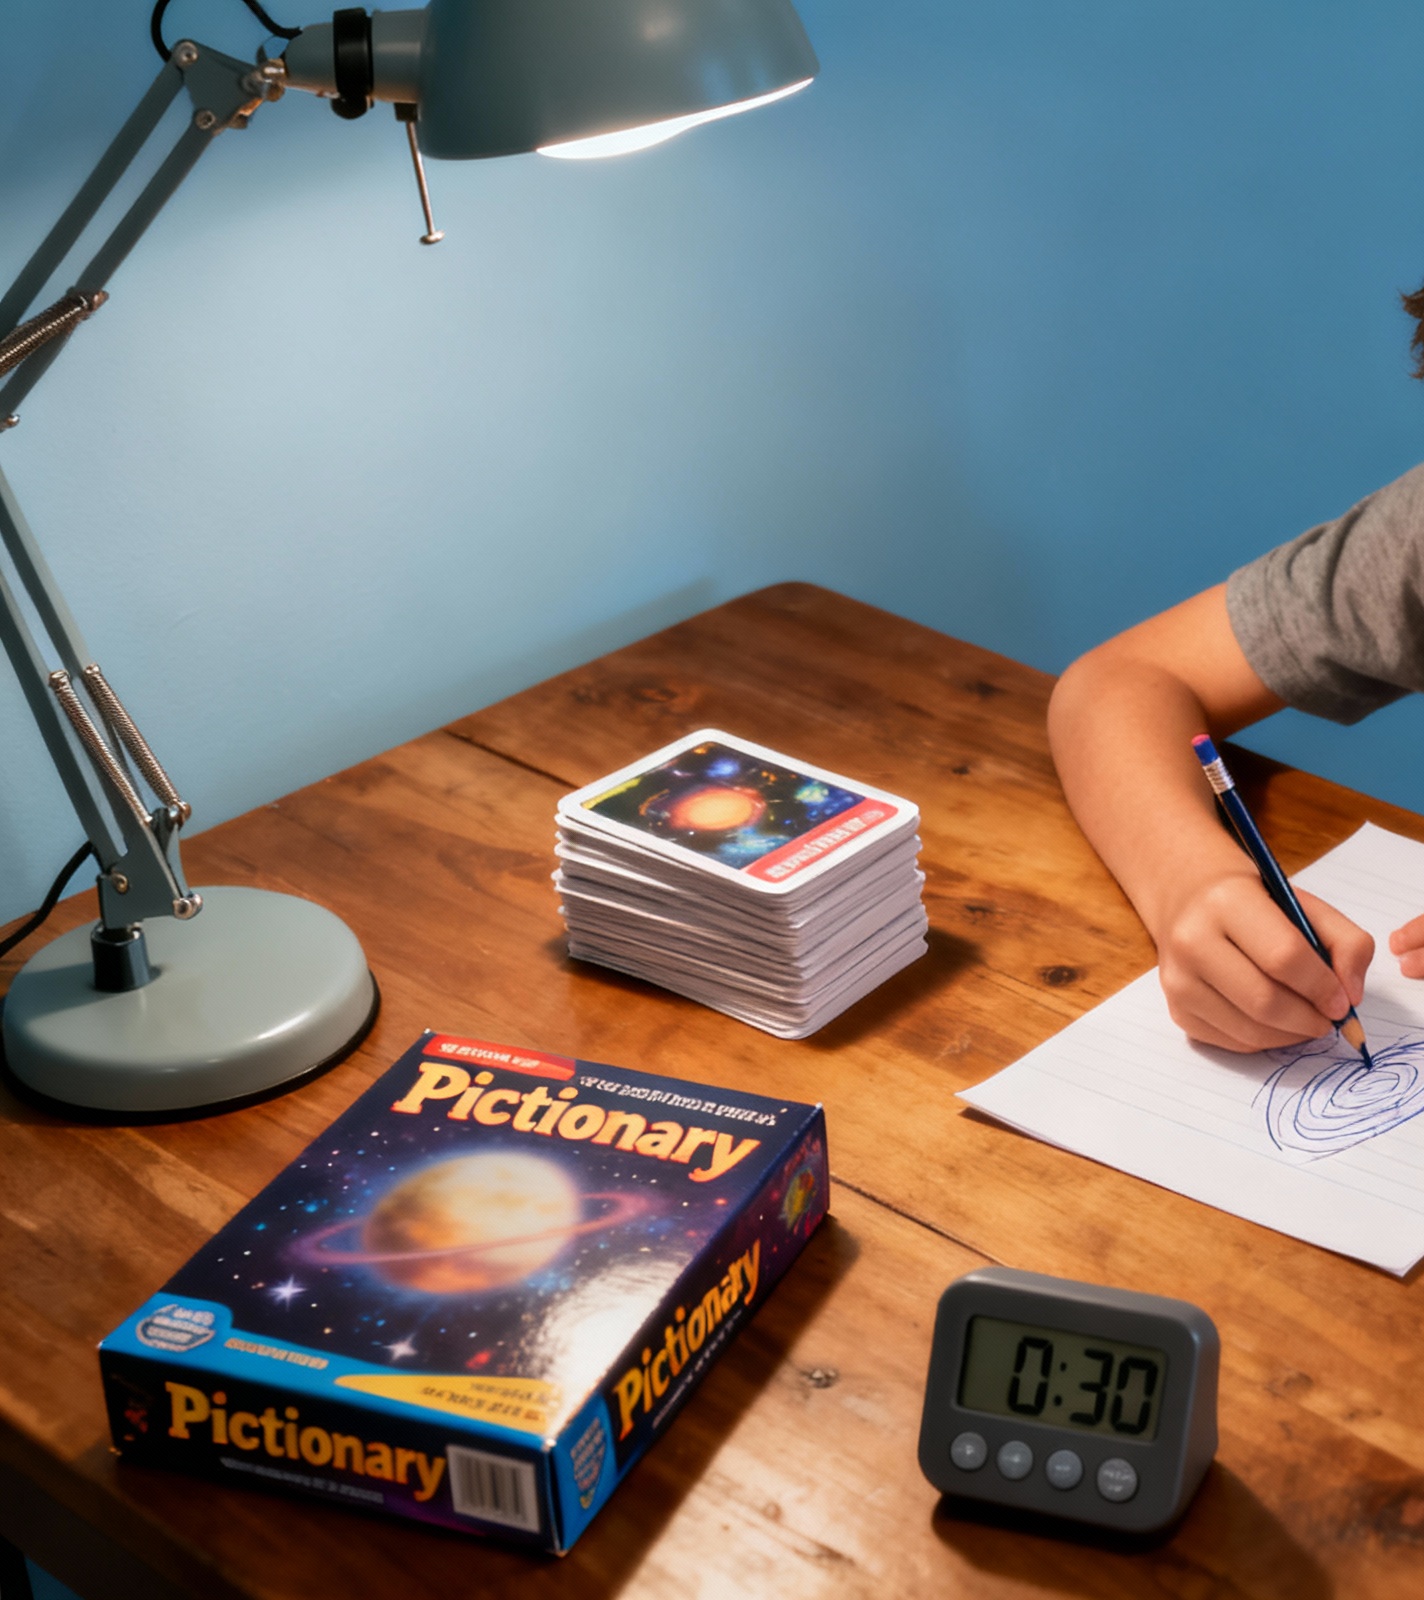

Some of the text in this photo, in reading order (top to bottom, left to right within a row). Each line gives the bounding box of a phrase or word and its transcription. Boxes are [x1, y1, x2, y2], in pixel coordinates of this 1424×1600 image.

[391, 1062, 761, 1182] Pictionary
[613, 1240, 760, 1441] Pictionary
[1008, 1336, 1158, 1435] 0:30
[165, 1381, 446, 1502] Pictionary
